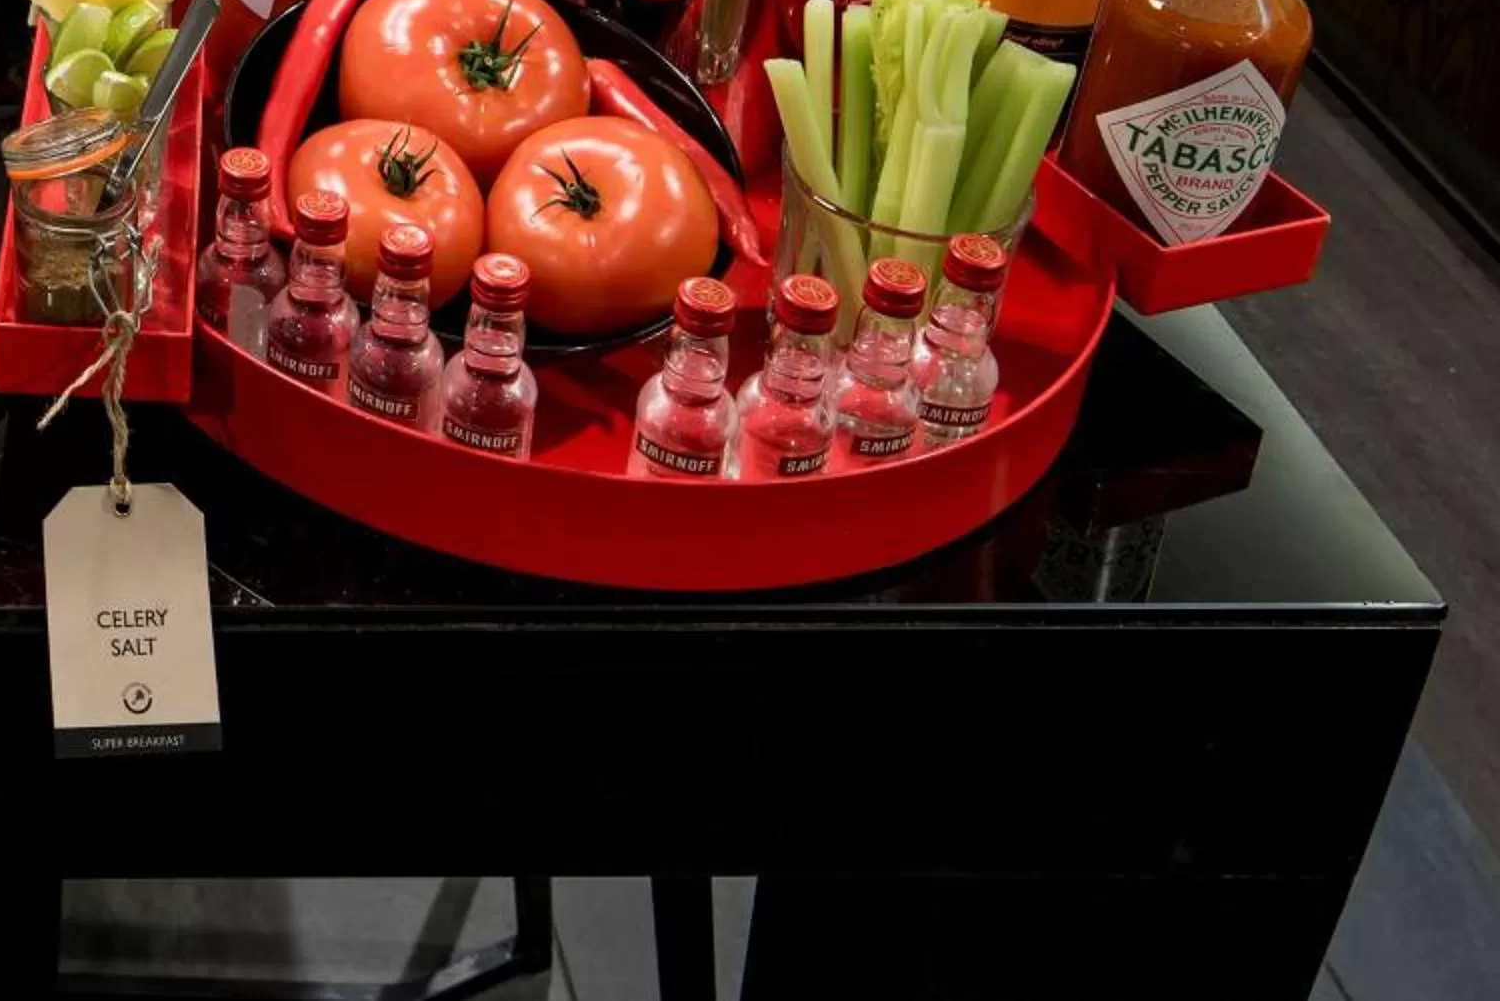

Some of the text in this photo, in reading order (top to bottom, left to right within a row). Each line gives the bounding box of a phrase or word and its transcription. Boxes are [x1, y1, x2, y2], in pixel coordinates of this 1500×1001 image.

[1142, 161, 1201, 214] PEPPER
[1174, 173, 1235, 191] BRAND
[268, 346, 333, 377] SMIRNOFF
[446, 421, 518, 449] SMIRNOFF
[639, 437, 716, 473] SMIRNOFF
[96, 608, 169, 629] CELERY
[110, 637, 157, 657] SALT
[91, 737, 123, 750] SUPER
